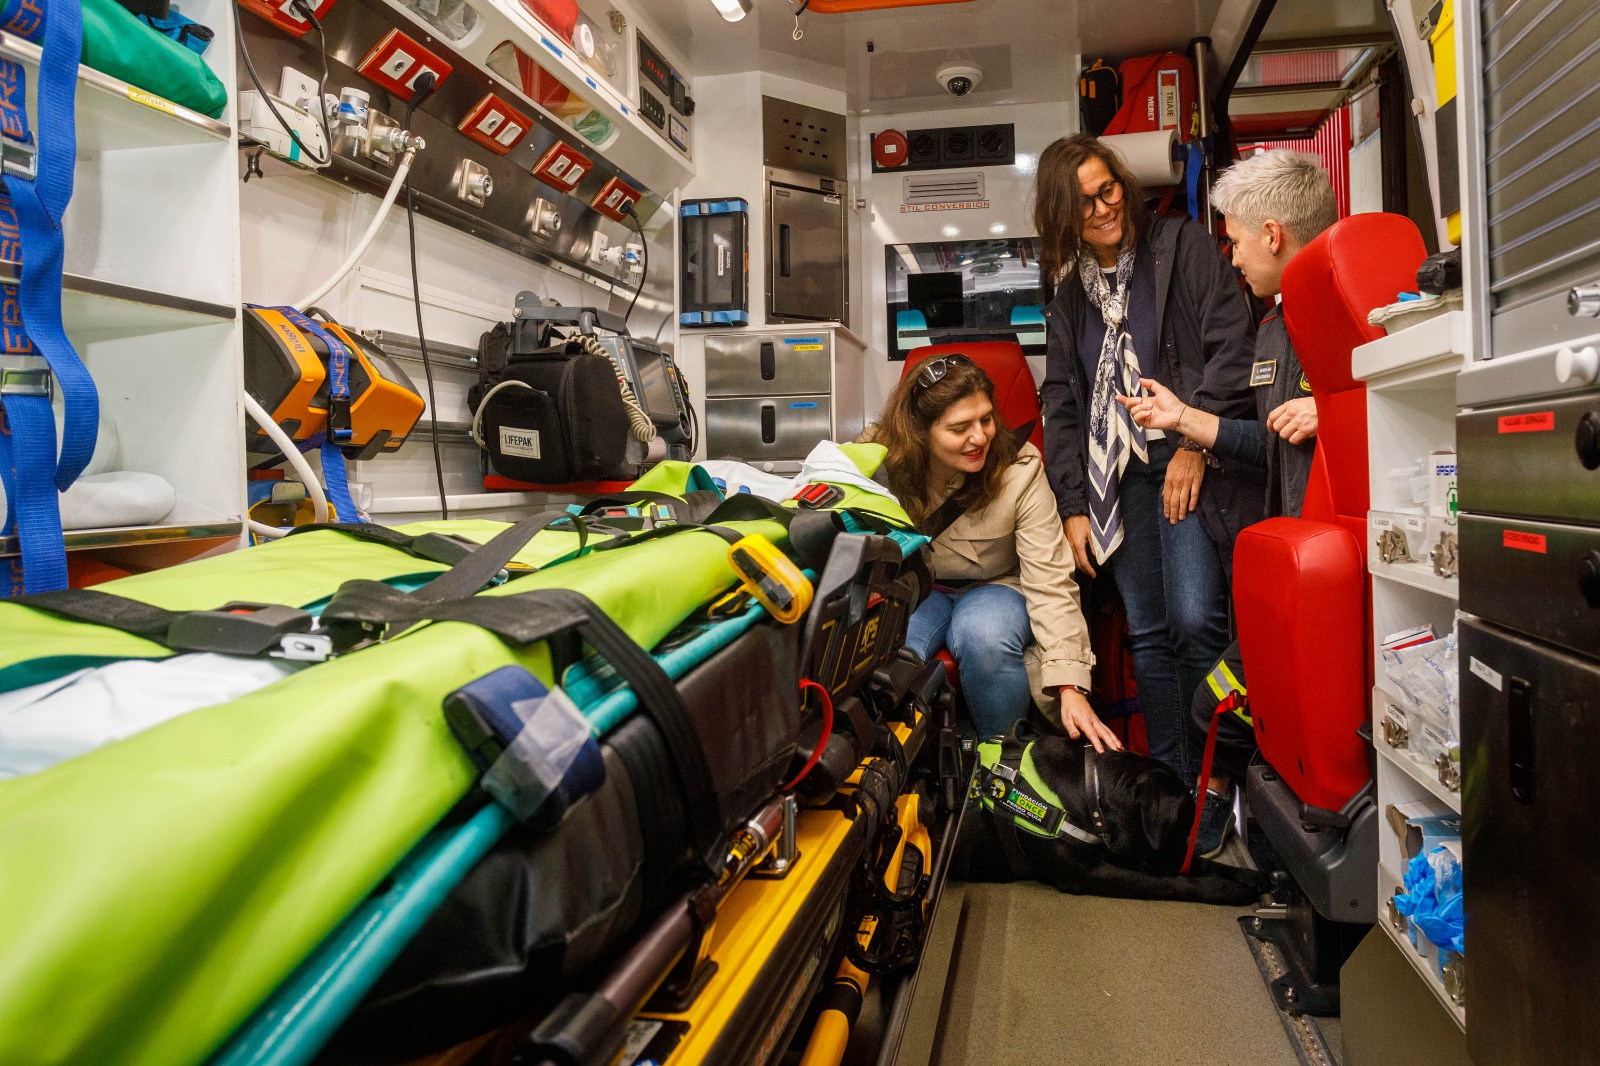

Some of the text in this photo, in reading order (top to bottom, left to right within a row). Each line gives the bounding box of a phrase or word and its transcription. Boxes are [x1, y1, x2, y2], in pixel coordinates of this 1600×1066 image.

[1147, 96, 1155, 121] MERET
[1166, 91, 1174, 117] TRIAJE
[900, 201, 990, 213] STIL CONVERSION
[504, 434, 534, 447] LIFEPAK
[1006, 799, 1027, 813] PERRO
[1012, 788, 1048, 811] FUNDACIÓN
[1019, 799, 1044, 816] ONCE
